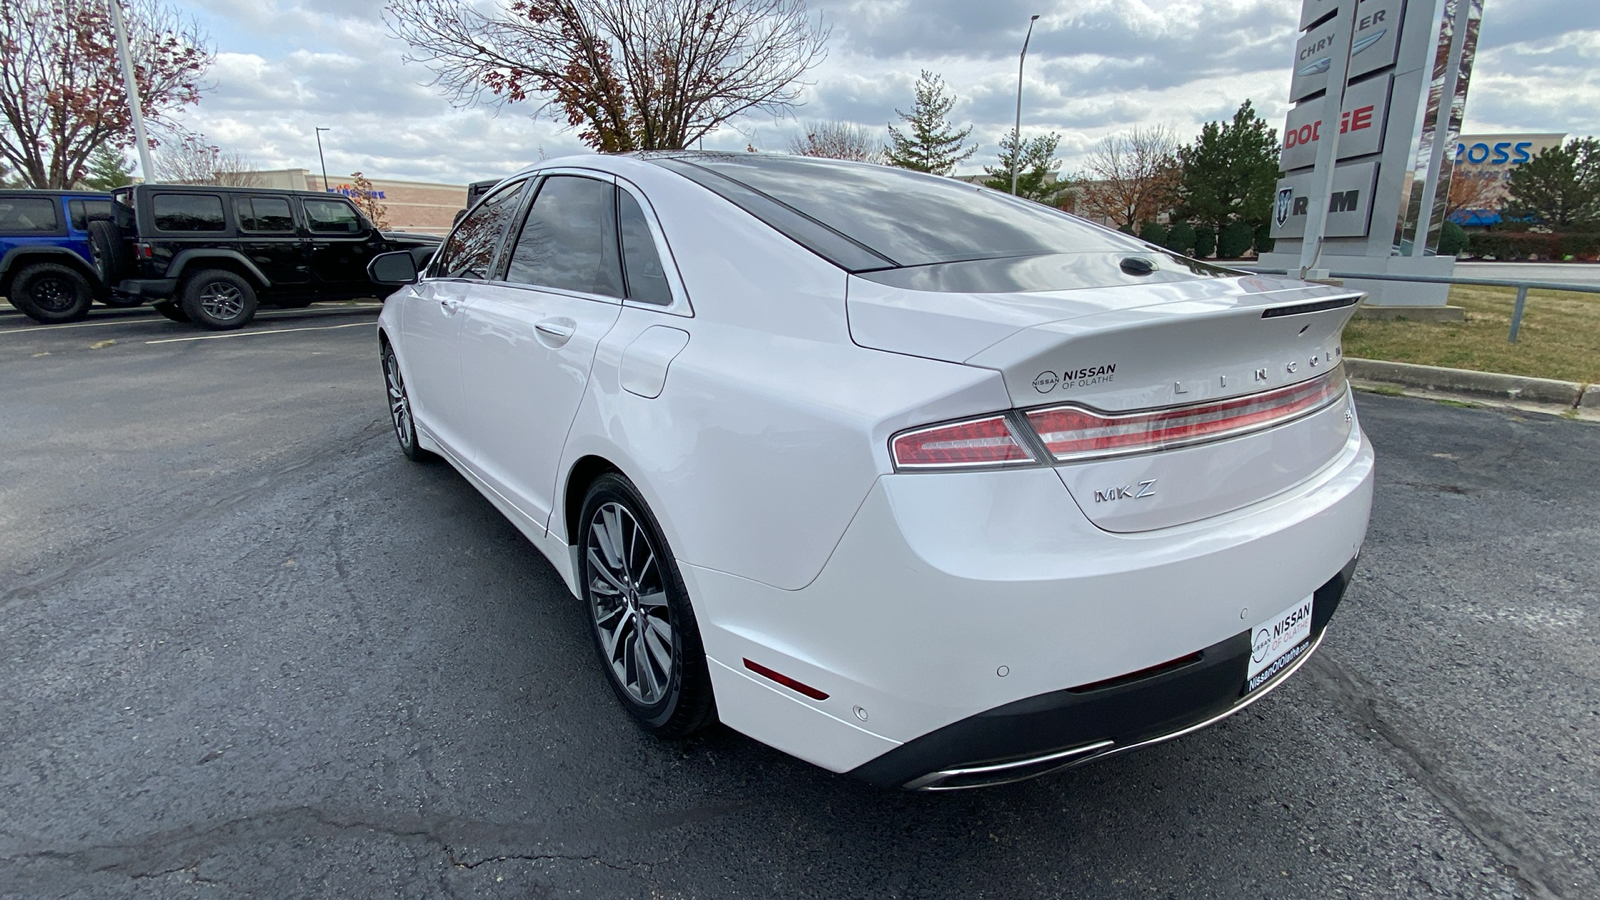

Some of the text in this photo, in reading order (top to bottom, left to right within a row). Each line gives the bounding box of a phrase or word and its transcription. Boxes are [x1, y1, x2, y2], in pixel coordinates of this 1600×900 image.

[1300, 9, 1387, 61] CHRYER
[1292, 190, 1359, 216] RM
[1032, 377, 1059, 386] NISSAN
[1062, 374, 1114, 390] OF OLATHE
[1063, 363, 1117, 381] NISSAN
[1174, 346, 1341, 395] LINCOLN
[1094, 478, 1157, 503] MKZ
[1273, 602, 1311, 639] NISSAN
[1271, 617, 1310, 651] OF OLATHE
